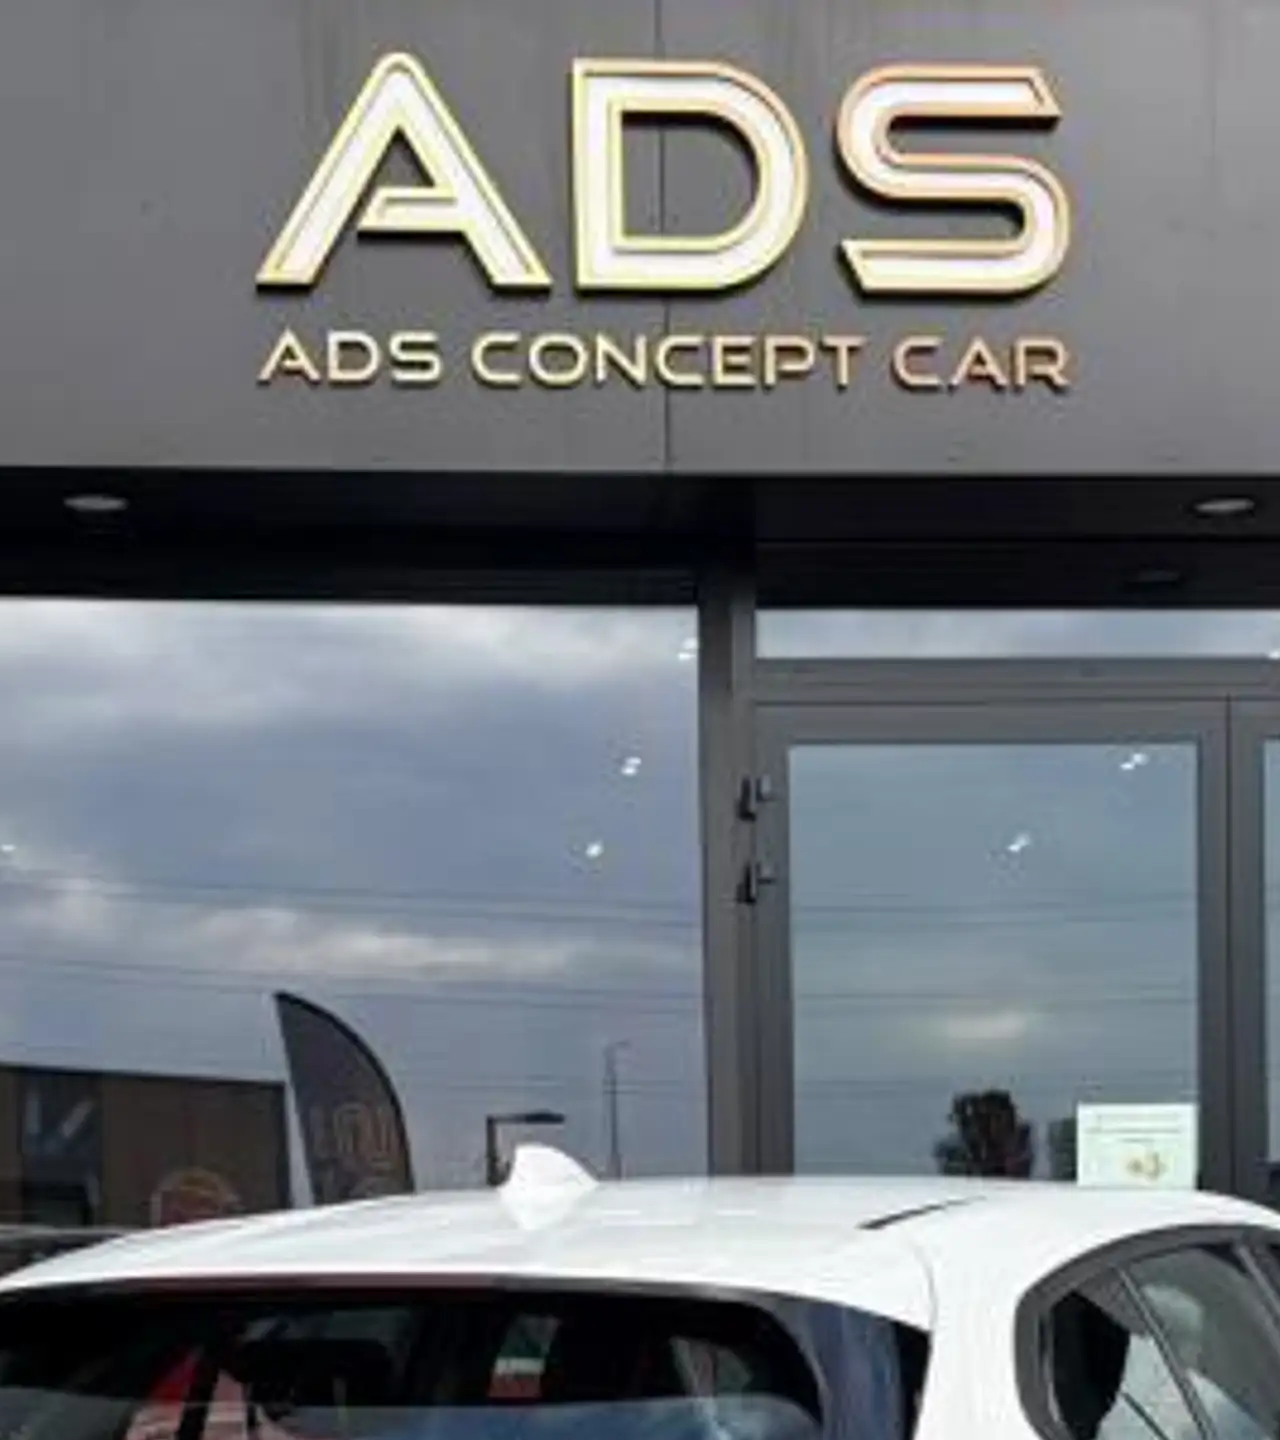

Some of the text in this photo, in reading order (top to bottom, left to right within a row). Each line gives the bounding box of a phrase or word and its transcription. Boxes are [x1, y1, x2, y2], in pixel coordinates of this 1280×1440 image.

[256, 52, 1071, 294] ADS
[256, 330, 1072, 390] ADS CONCEPT CAR
